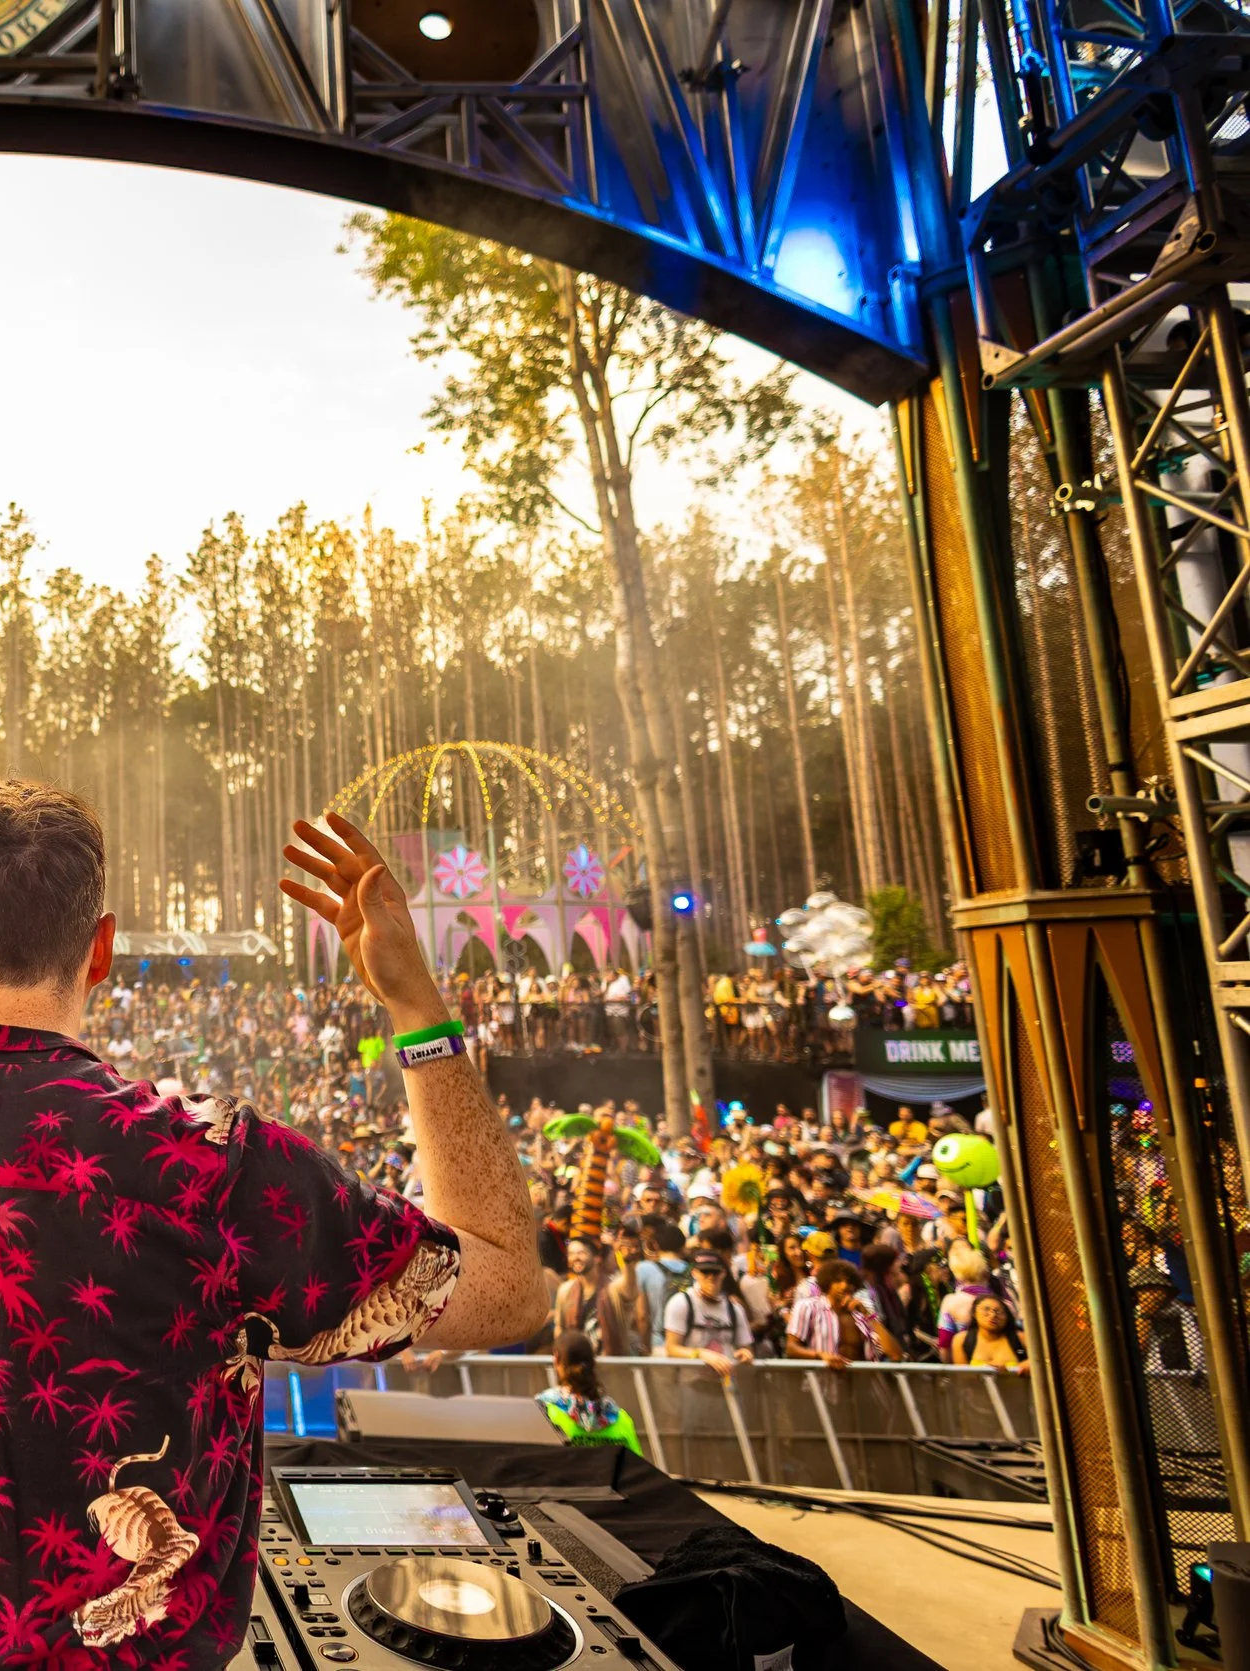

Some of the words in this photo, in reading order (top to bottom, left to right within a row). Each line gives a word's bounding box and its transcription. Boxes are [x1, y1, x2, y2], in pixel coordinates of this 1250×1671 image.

[411, 1046, 443, 1060] ARTIST
[885, 1040, 946, 1062] DRINK
[948, 1040, 980, 1062] ME
